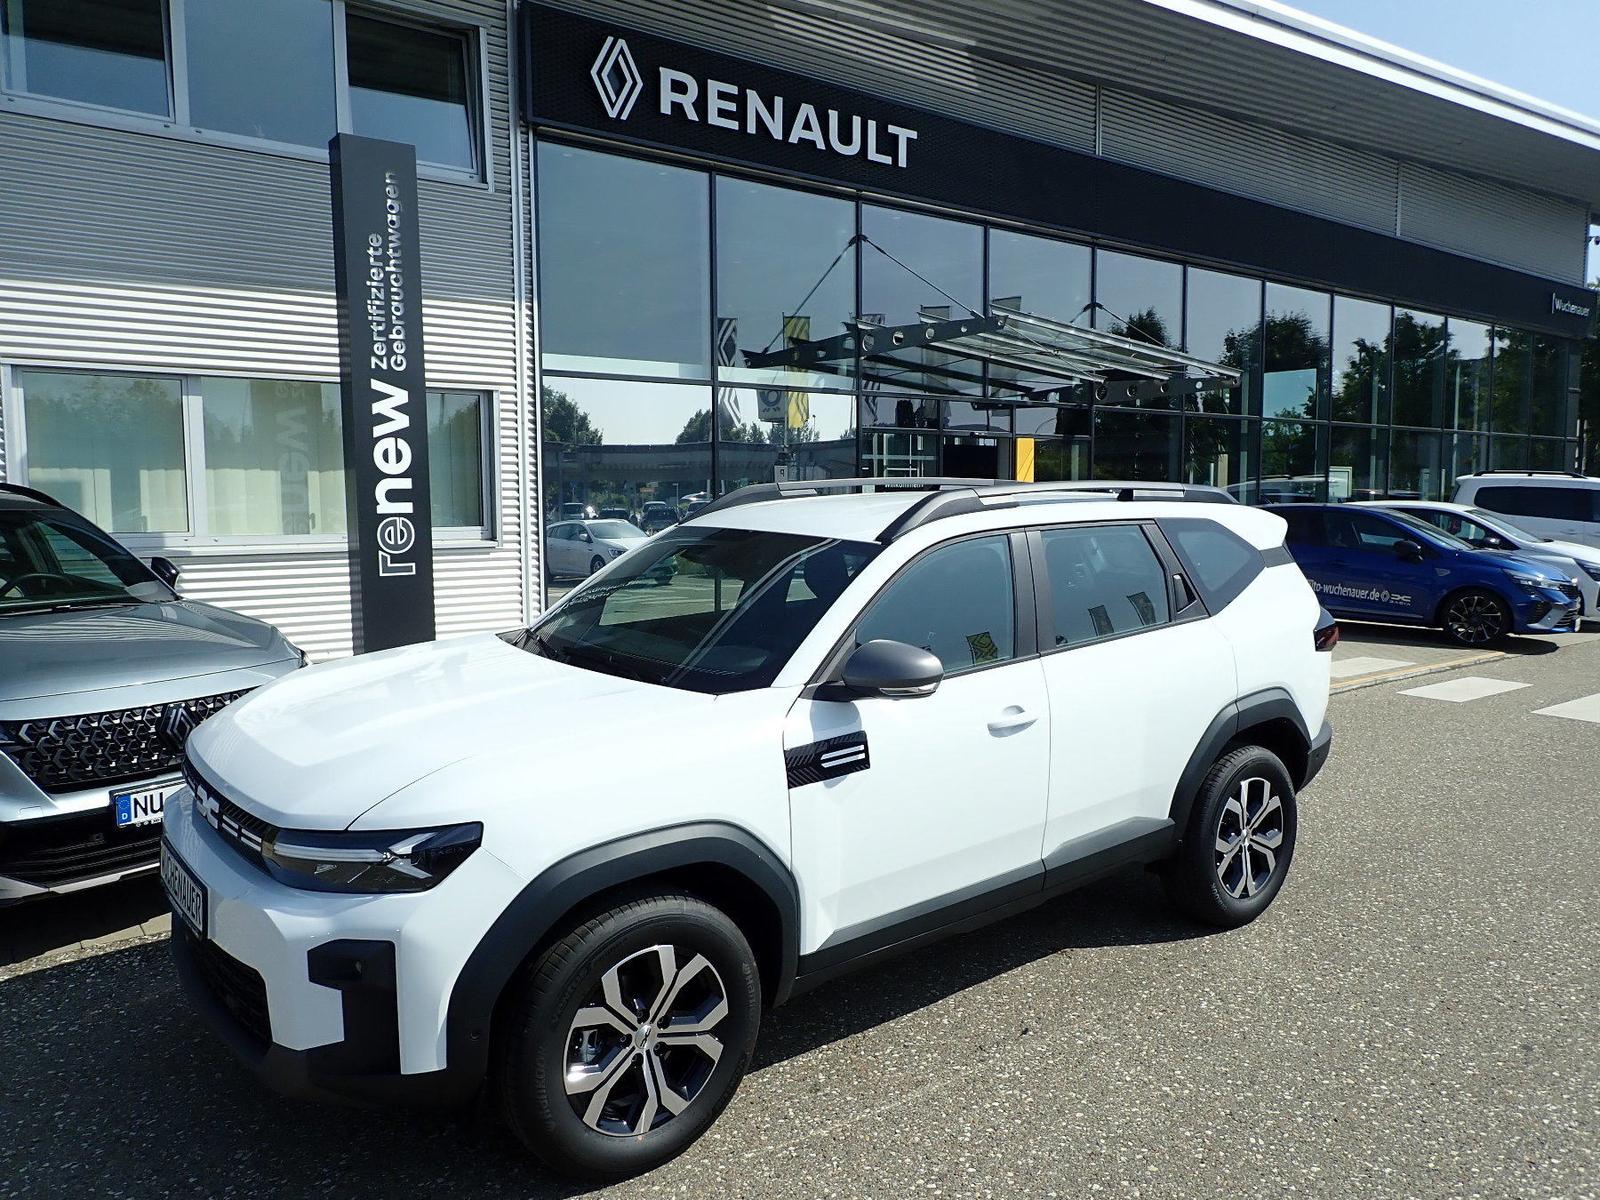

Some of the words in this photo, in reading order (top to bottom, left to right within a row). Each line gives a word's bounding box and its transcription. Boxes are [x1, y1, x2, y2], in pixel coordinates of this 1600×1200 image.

[659, 66, 918, 168] RENAULT
[366, 233, 388, 371] Zertifizierte
[385, 170, 407, 372] Gebrauchtwagen
[1555, 298, 1590, 317] Wuchenauer
[370, 378, 416, 577] renew
[134, 792, 163, 818] NU
